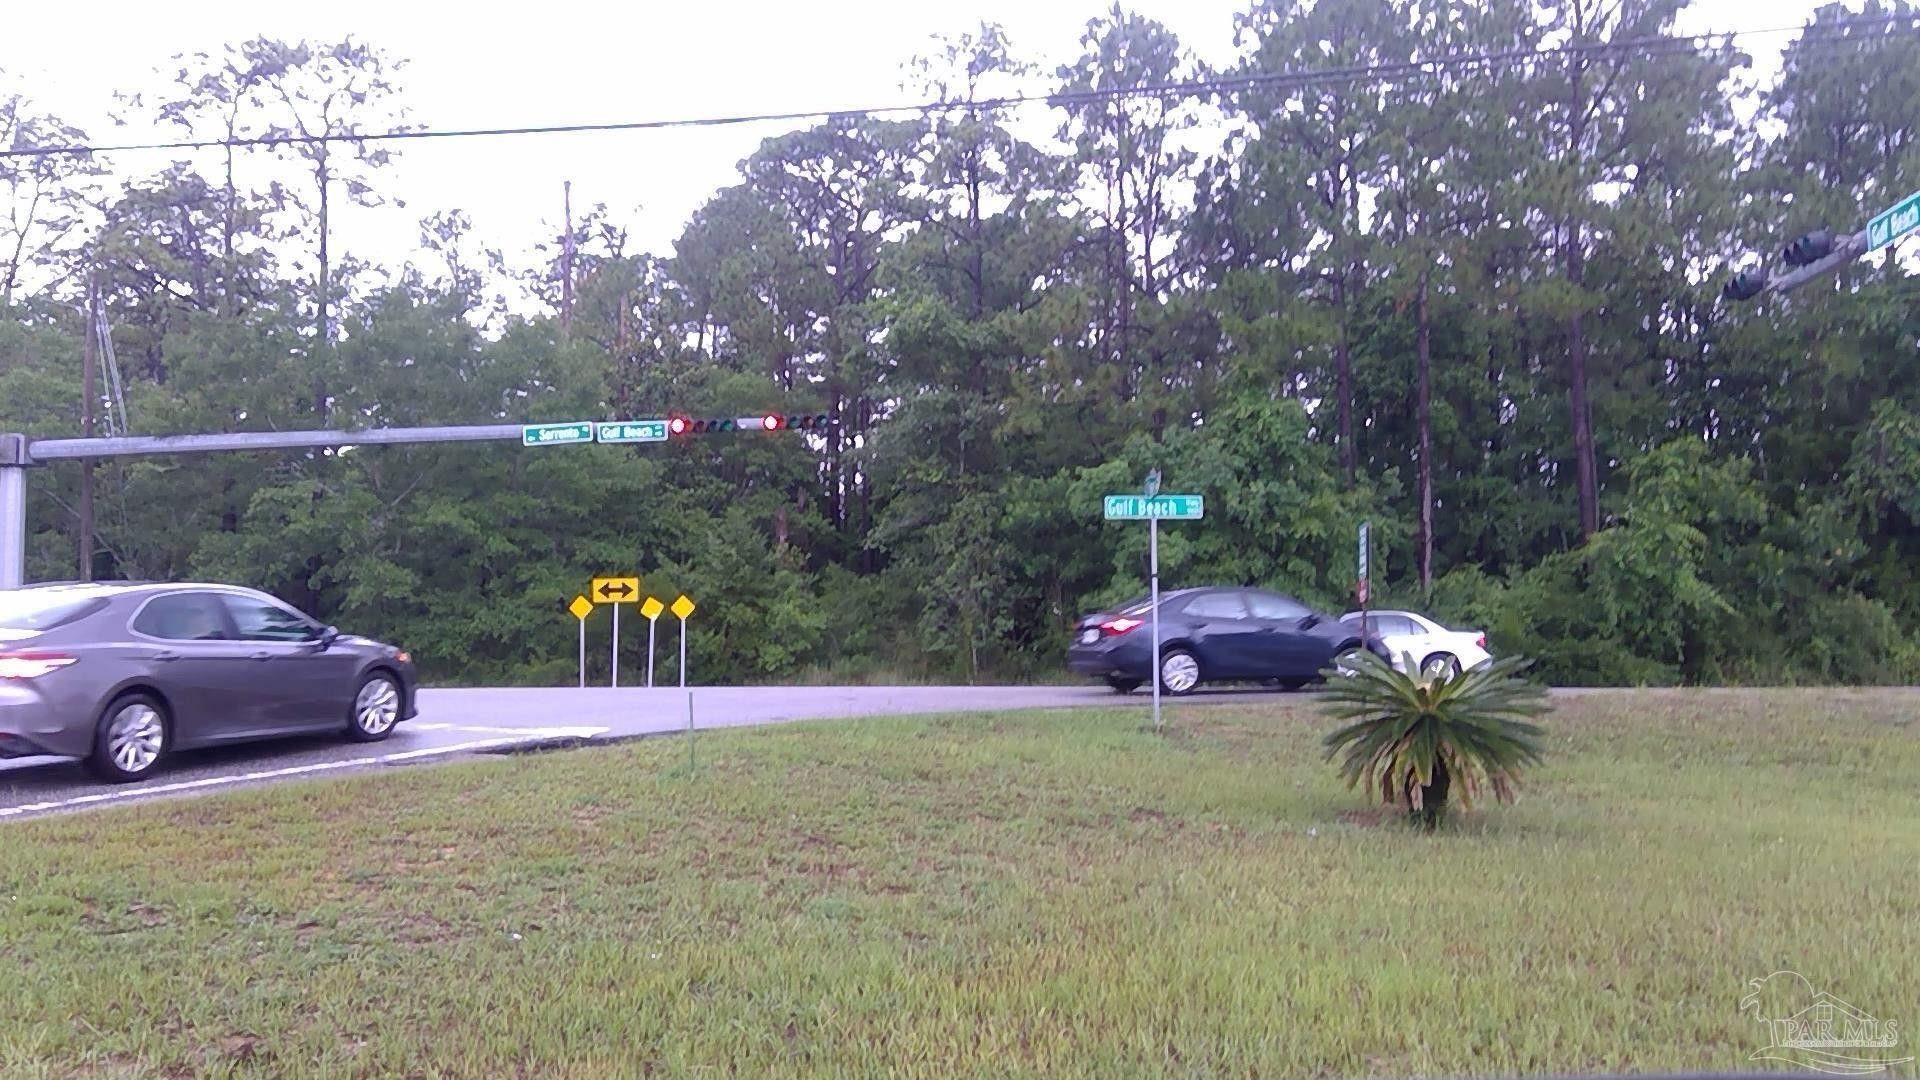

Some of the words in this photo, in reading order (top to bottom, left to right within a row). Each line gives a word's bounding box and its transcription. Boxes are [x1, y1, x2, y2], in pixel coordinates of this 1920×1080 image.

[602, 427, 620, 439] Gulf
[623, 426, 653, 438] Beach
[1108, 498, 1133, 516] Gulf
[1138, 498, 1177, 516] Beach
